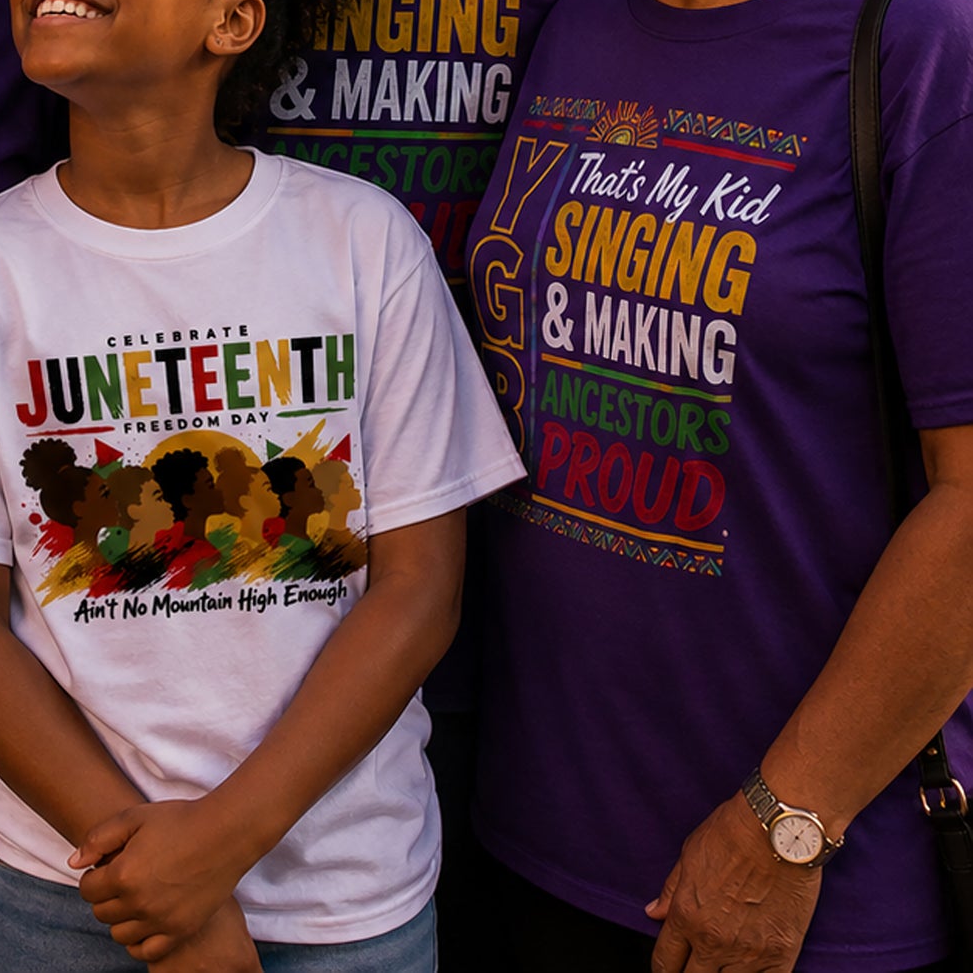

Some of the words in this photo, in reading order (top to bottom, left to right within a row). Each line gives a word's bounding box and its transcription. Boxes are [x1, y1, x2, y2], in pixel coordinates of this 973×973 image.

[269, 57, 317, 121] &
[330, 58, 513, 124] MAKING
[569, 151, 647, 202] That's
[644, 162, 699, 223] My
[700, 172, 782, 225] Kid
[545, 200, 758, 315] SINGING
[107, 325, 250, 348] CELEBRATE
[542, 282, 575, 352] &
[584, 291, 737, 385] MAKING
[15, 333, 356, 427] JUNETEENTH
[540, 369, 732, 455] ANCESTORS
[123, 415, 220, 434] FREEDOM
[231, 411, 271, 426] DAY
[536, 421, 726, 531] PROUD
[74, 597, 118, 623] Ain't
[122, 599, 148, 619] No
[152, 589, 233, 616] Mountain
[237, 587, 278, 613] High
[283, 580, 348, 610] Enough
